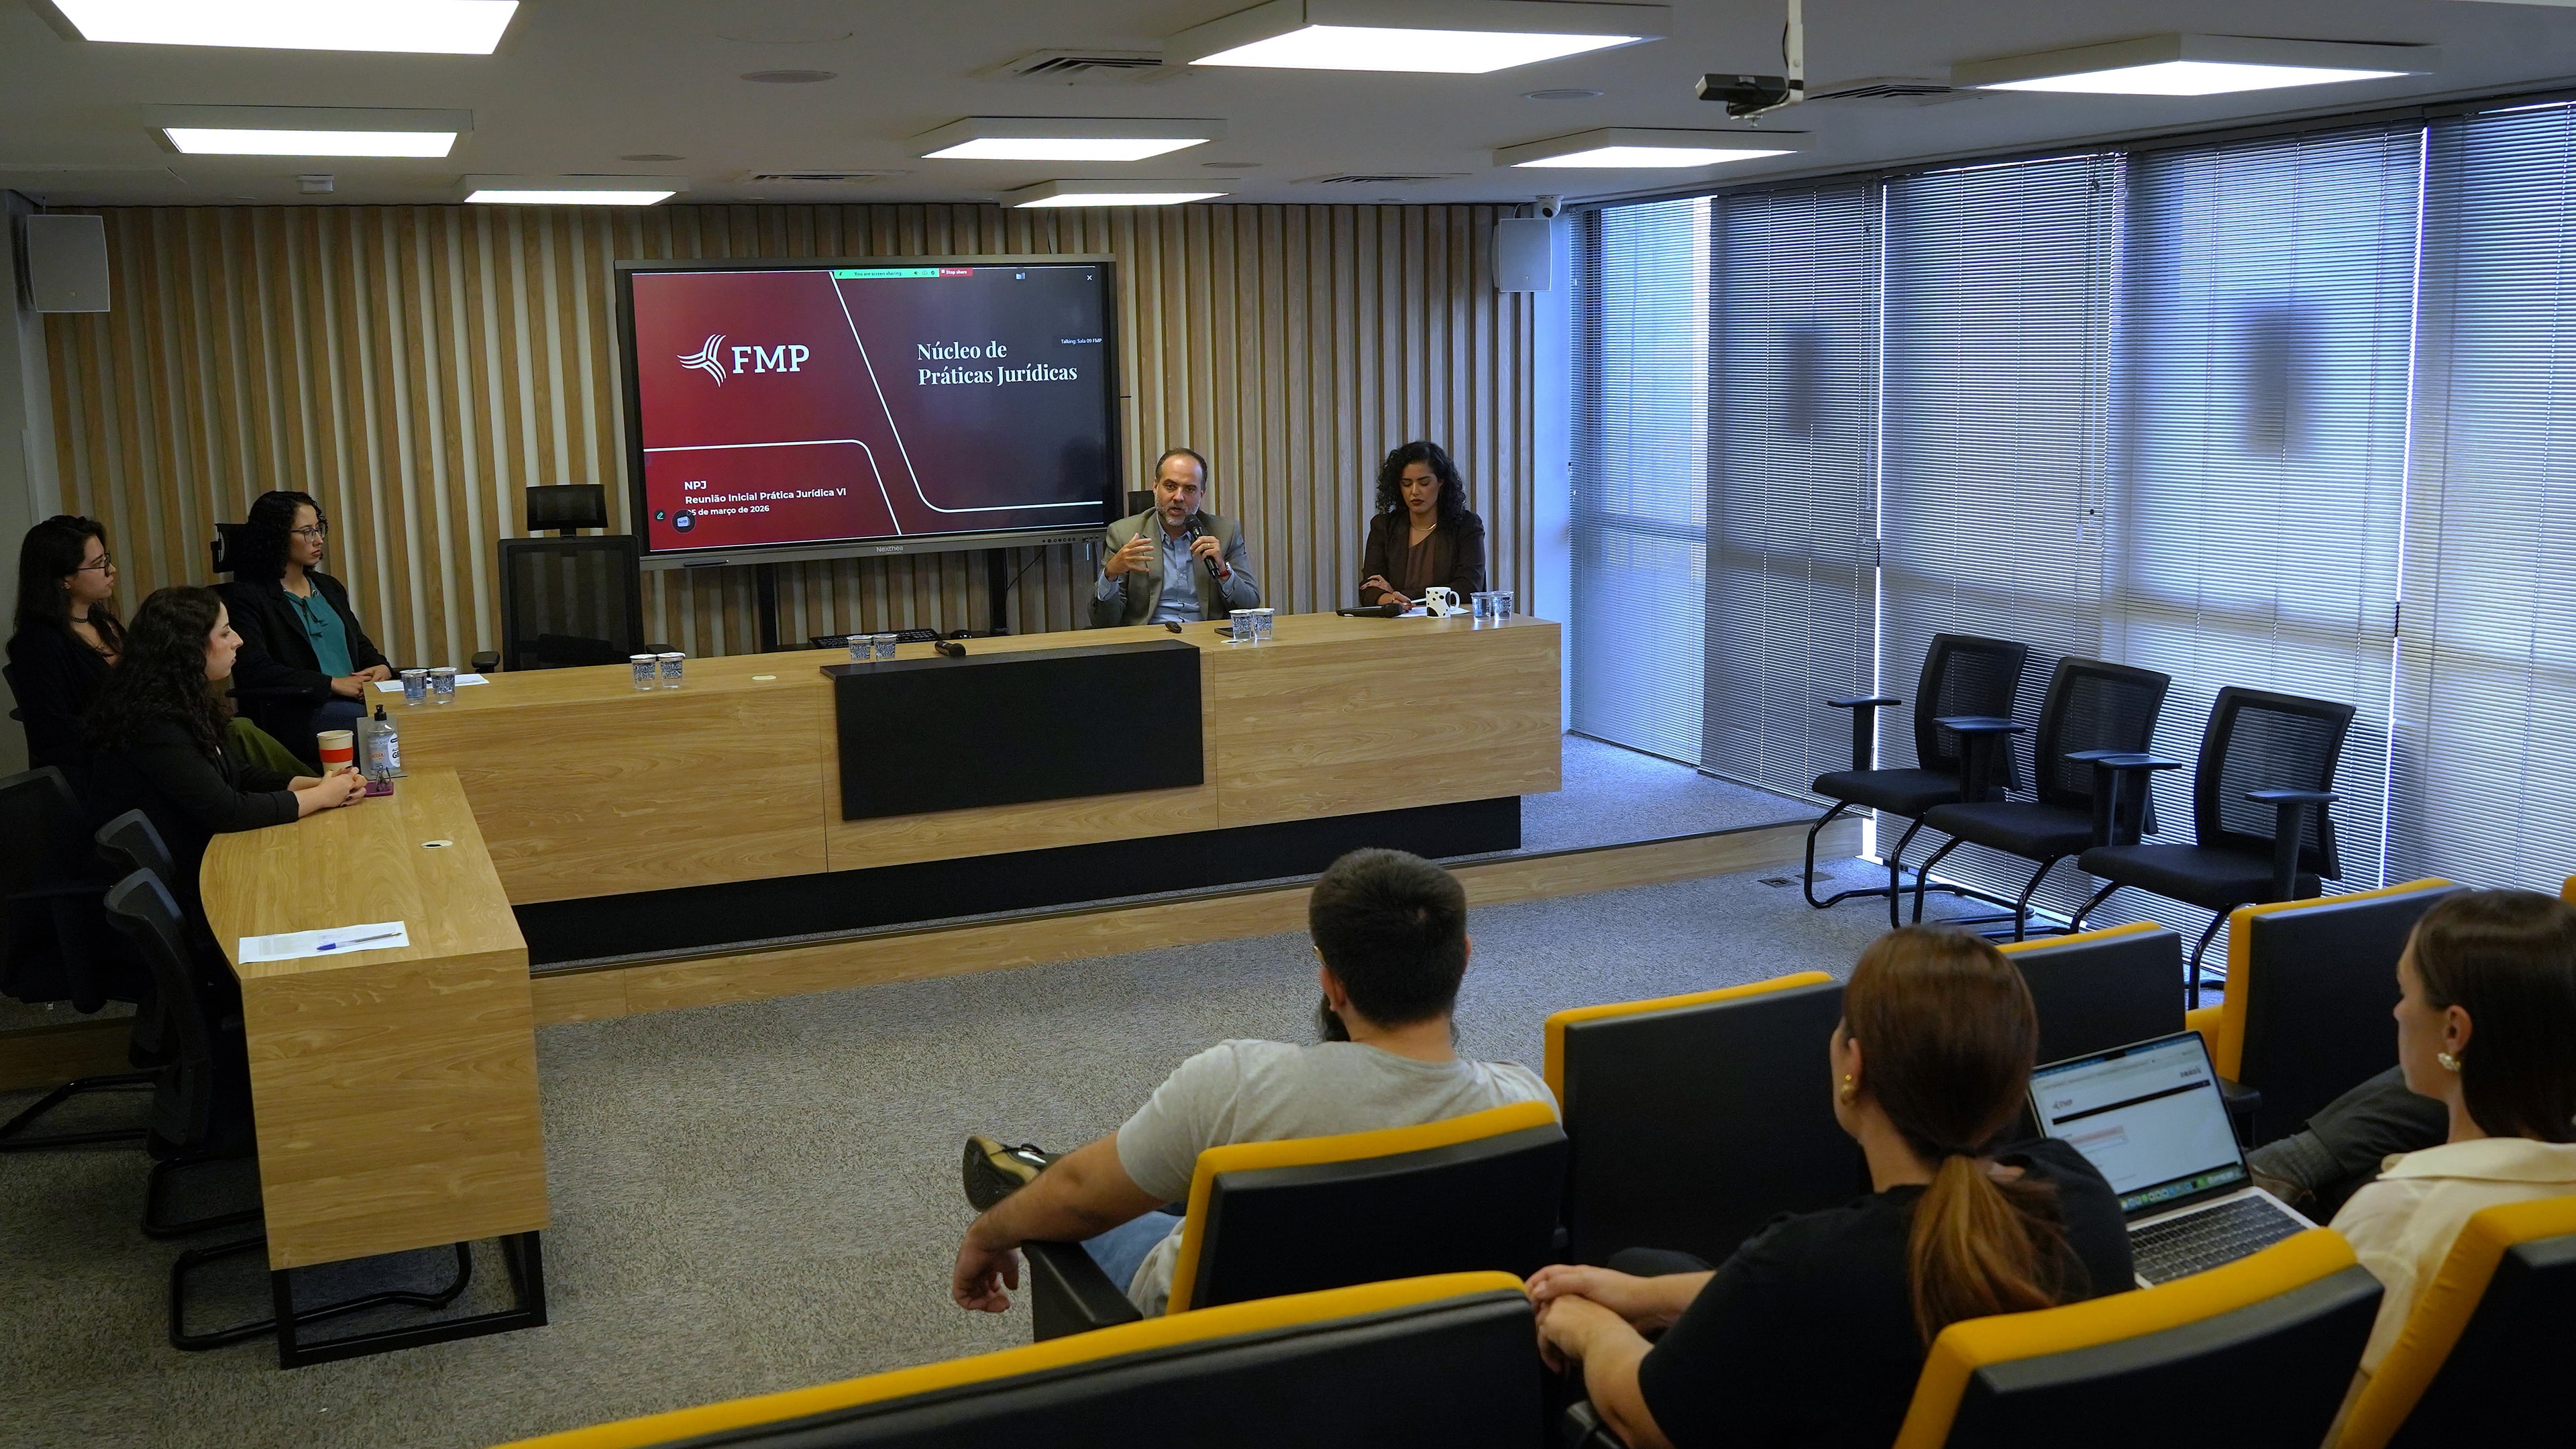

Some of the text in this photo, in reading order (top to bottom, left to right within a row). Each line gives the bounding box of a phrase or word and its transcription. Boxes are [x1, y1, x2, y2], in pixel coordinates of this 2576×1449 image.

[917, 341, 1007, 360] Núcleo de
[731, 345, 810, 374] FMP
[918, 363, 1077, 386] Práticas Jurídicas
[684, 480, 707, 490] NPJ
[685, 488, 847, 504] Reunião Inicial Prática Jurídica VI
[710, 508, 736, 516] março
[738, 505, 749, 513] de
[750, 504, 769, 513] 2026
